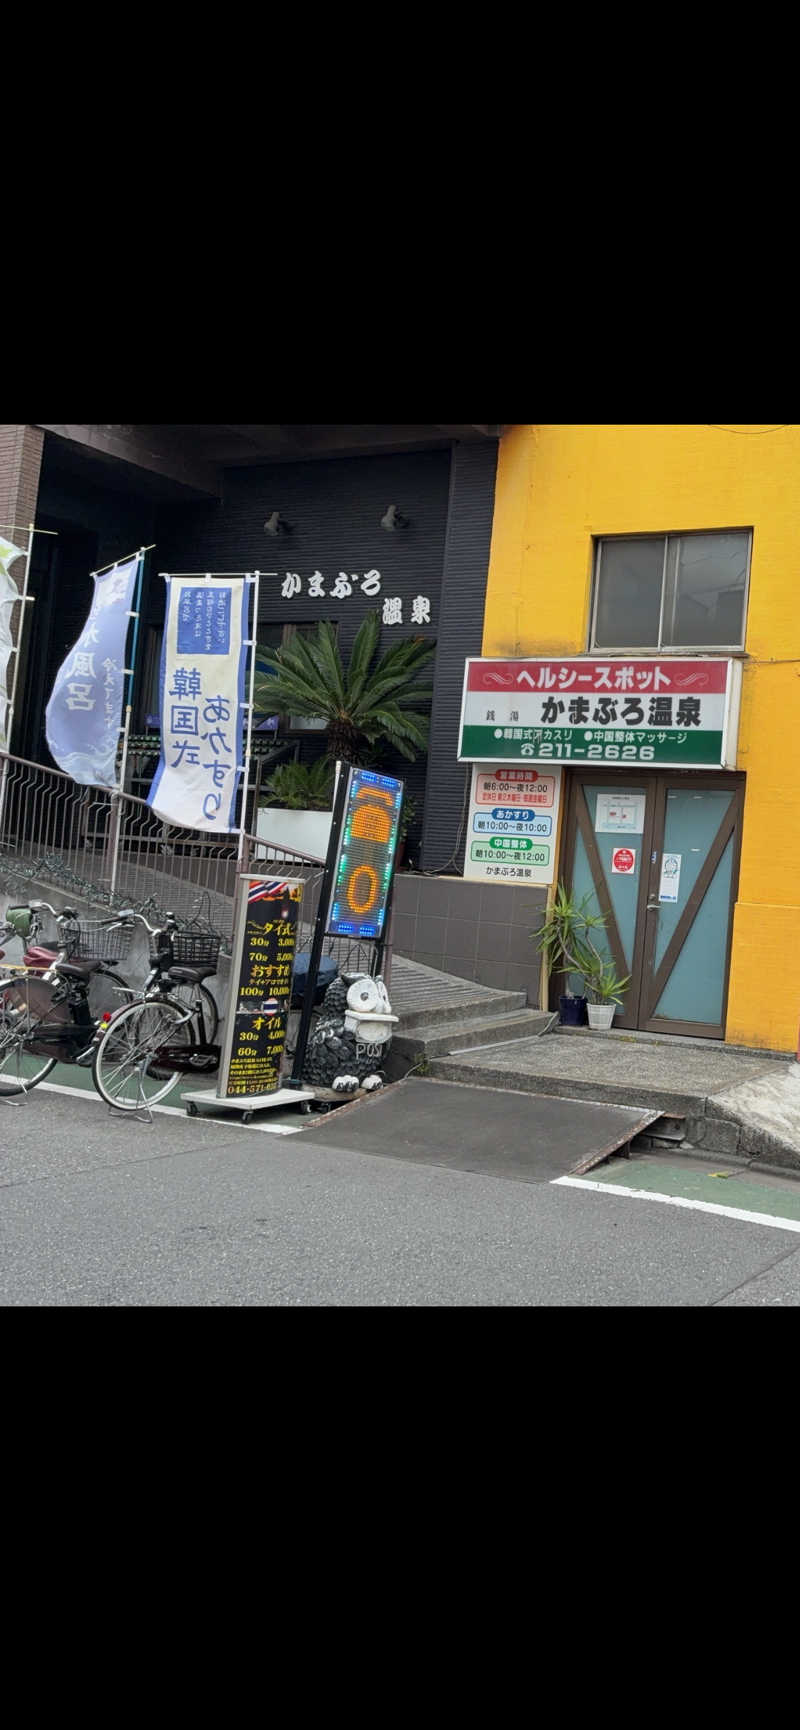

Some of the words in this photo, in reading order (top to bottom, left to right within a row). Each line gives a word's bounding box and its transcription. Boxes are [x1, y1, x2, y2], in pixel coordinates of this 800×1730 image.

[281, 569, 382, 600] かまぶろ
[382, 595, 431, 626] 温泉
[516, 666, 671, 691] ヘルシースポット
[540, 696, 702, 727] かまぶろ温泉
[538, 743, 655, 761] 211-2626
[496, 810, 530, 820] あかすり
[486, 866, 532, 877] かまぶろ温泉
[251, 1017, 281, 1031] オイル
